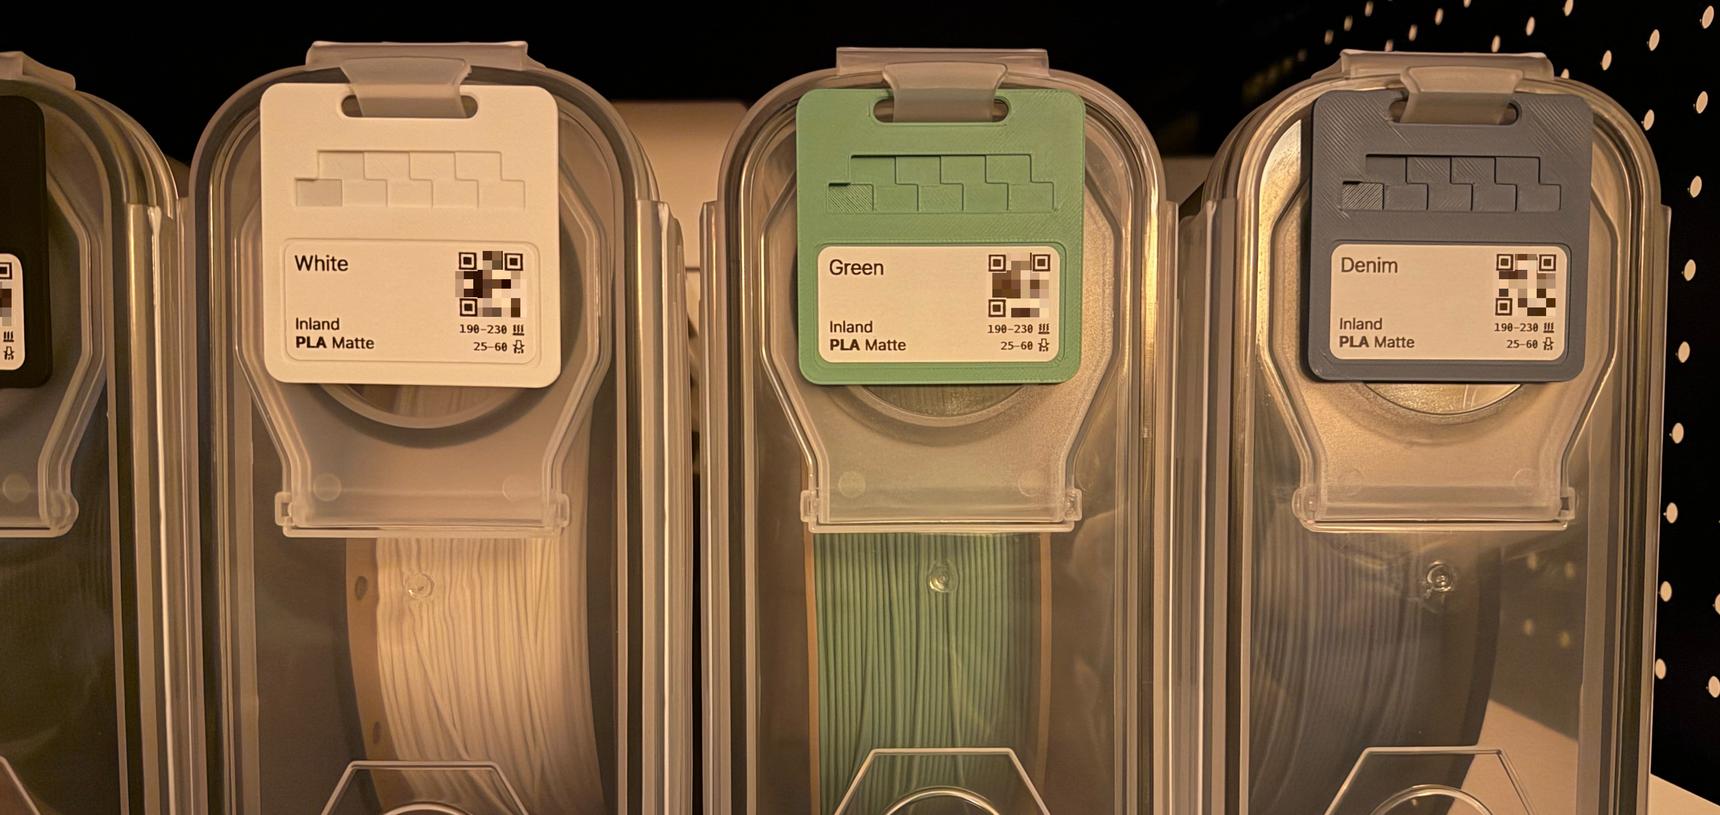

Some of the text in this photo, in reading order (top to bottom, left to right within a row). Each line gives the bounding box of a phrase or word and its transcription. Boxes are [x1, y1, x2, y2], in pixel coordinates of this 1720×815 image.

[294, 254, 349, 272] White
[829, 258, 884, 276] Green
[1340, 256, 1399, 274] Denim
[295, 317, 340, 331] Inland
[829, 320, 873, 334] Inland
[1339, 317, 1383, 331] Inland
[295, 336, 375, 350] PLA Matte
[829, 338, 907, 352] PLA Matte
[1339, 335, 1415, 349] PLA Matte
